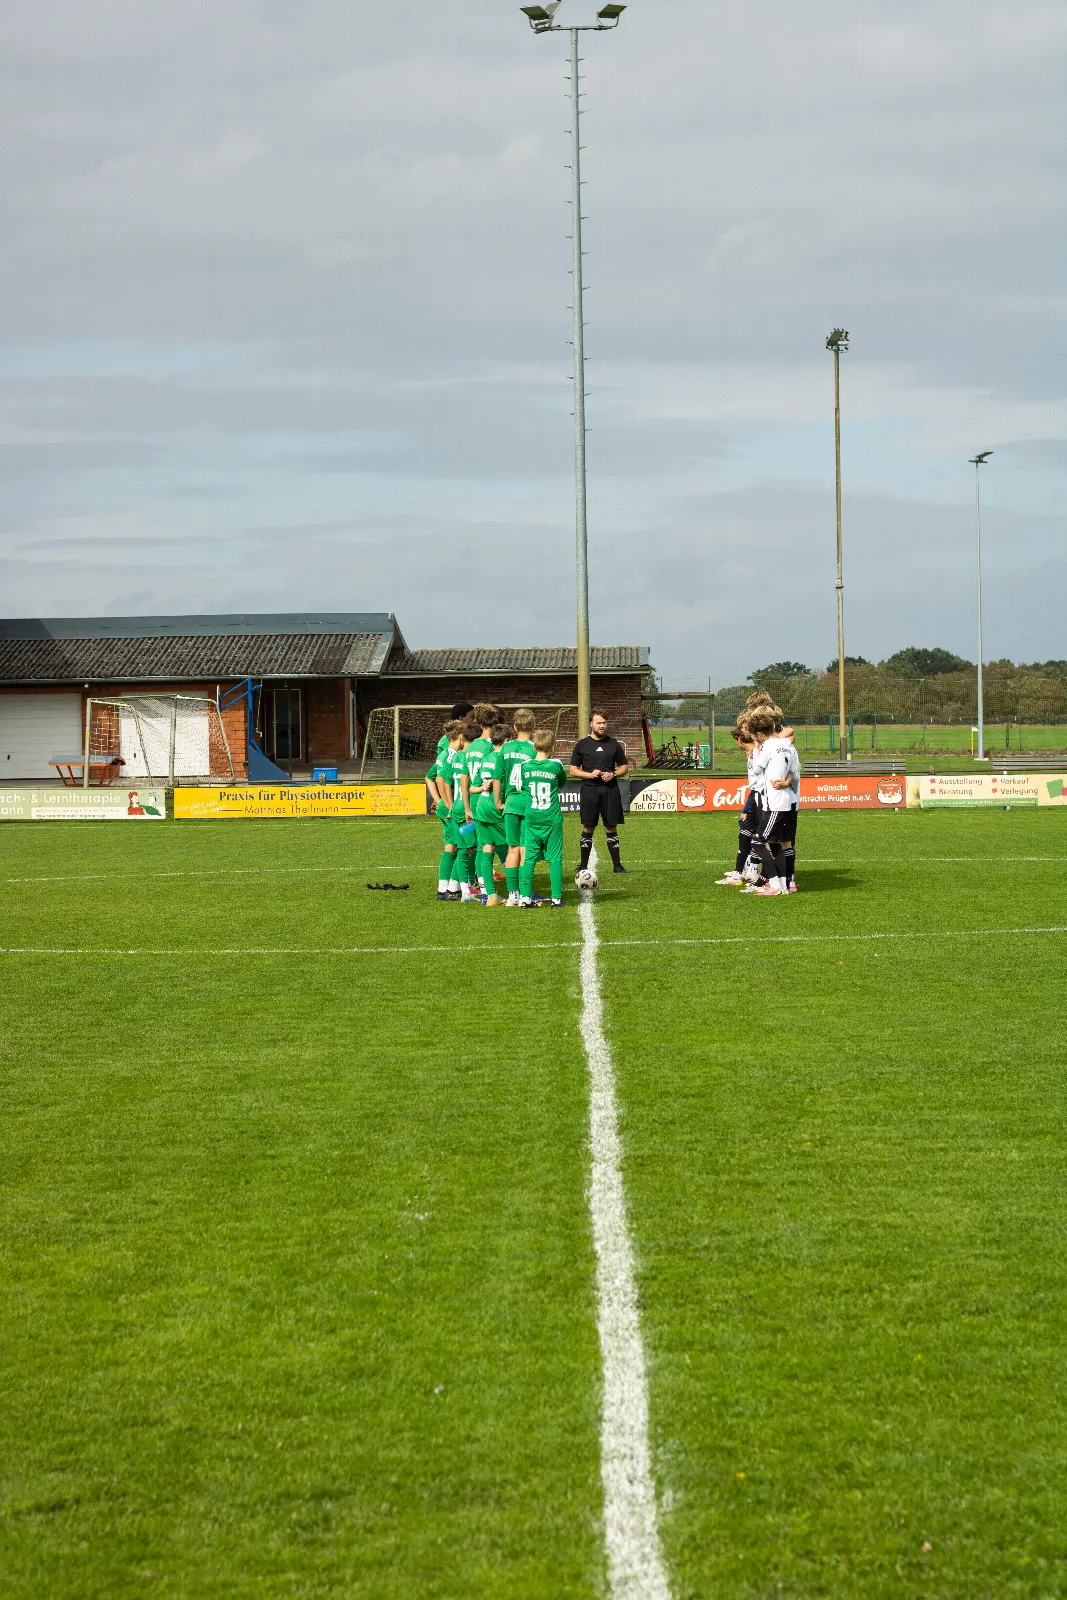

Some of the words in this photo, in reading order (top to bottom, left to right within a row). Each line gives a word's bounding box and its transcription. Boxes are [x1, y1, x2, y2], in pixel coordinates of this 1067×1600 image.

[509, 763, 522, 792] 4
[938, 778, 983, 786] Ausstellung
[1000, 777, 1029, 785] Verkauf
[817, 783, 848, 792] wünscht
[938, 788, 973, 796] Beratung
[1000, 787, 1039, 795] Verlegung
[30, 793, 38, 804] &
[43, 793, 121, 806] Lerntherapie
[219, 790, 255, 801] Praxis
[258, 789, 276, 801] für
[279, 789, 365, 804] Physiotherapie
[528, 781, 552, 810] 18
[642, 793, 675, 802] INJOY
[827, 794, 851, 803] Prügel
[244, 805, 287, 814] Matthias
[290, 804, 339, 814] Theilmann
[569, 804, 575, 812] &
[634, 802, 646, 811] Tel.
